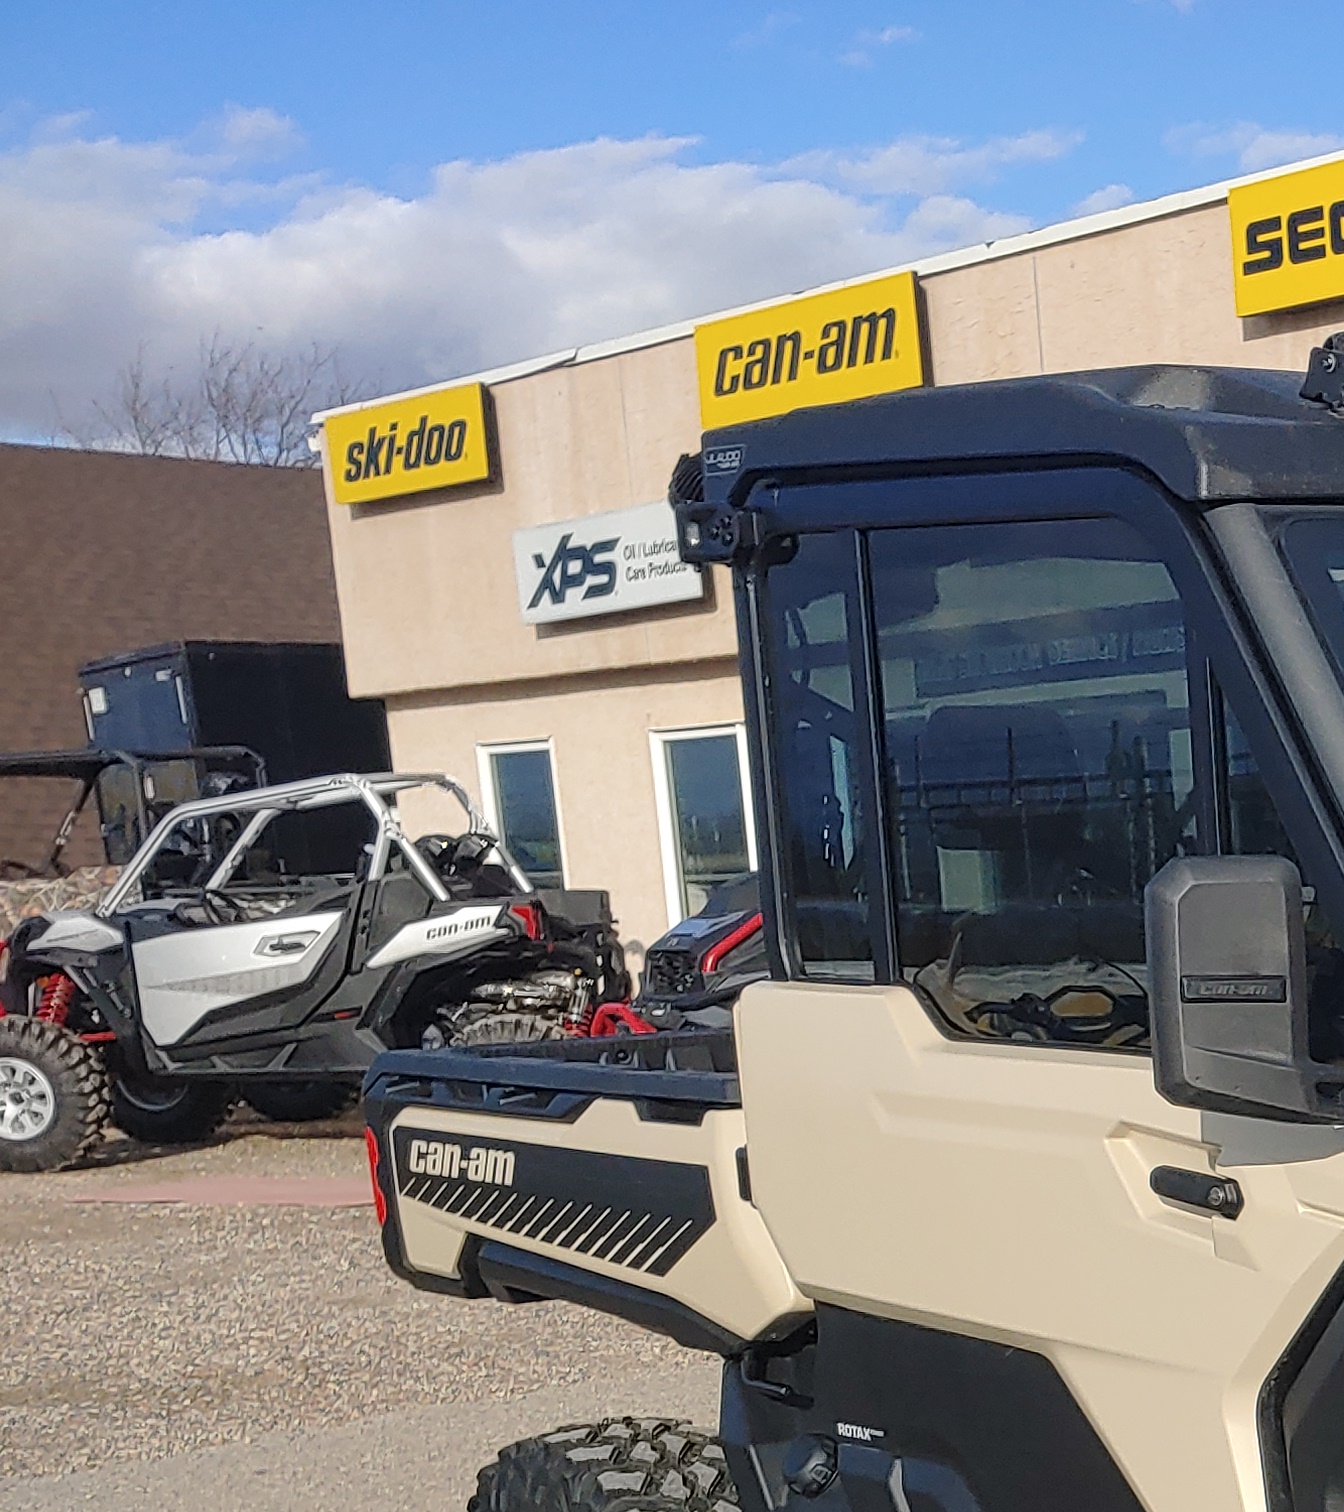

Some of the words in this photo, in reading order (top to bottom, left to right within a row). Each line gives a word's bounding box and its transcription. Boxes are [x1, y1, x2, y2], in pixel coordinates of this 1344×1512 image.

[714, 307, 896, 397] can-am
[344, 415, 467, 482] ski-doo
[526, 532, 622, 610] XPS
[625, 565, 646, 582] Care
[409, 1138, 516, 1187] can-am
[836, 1421, 872, 1441] ROTAX
